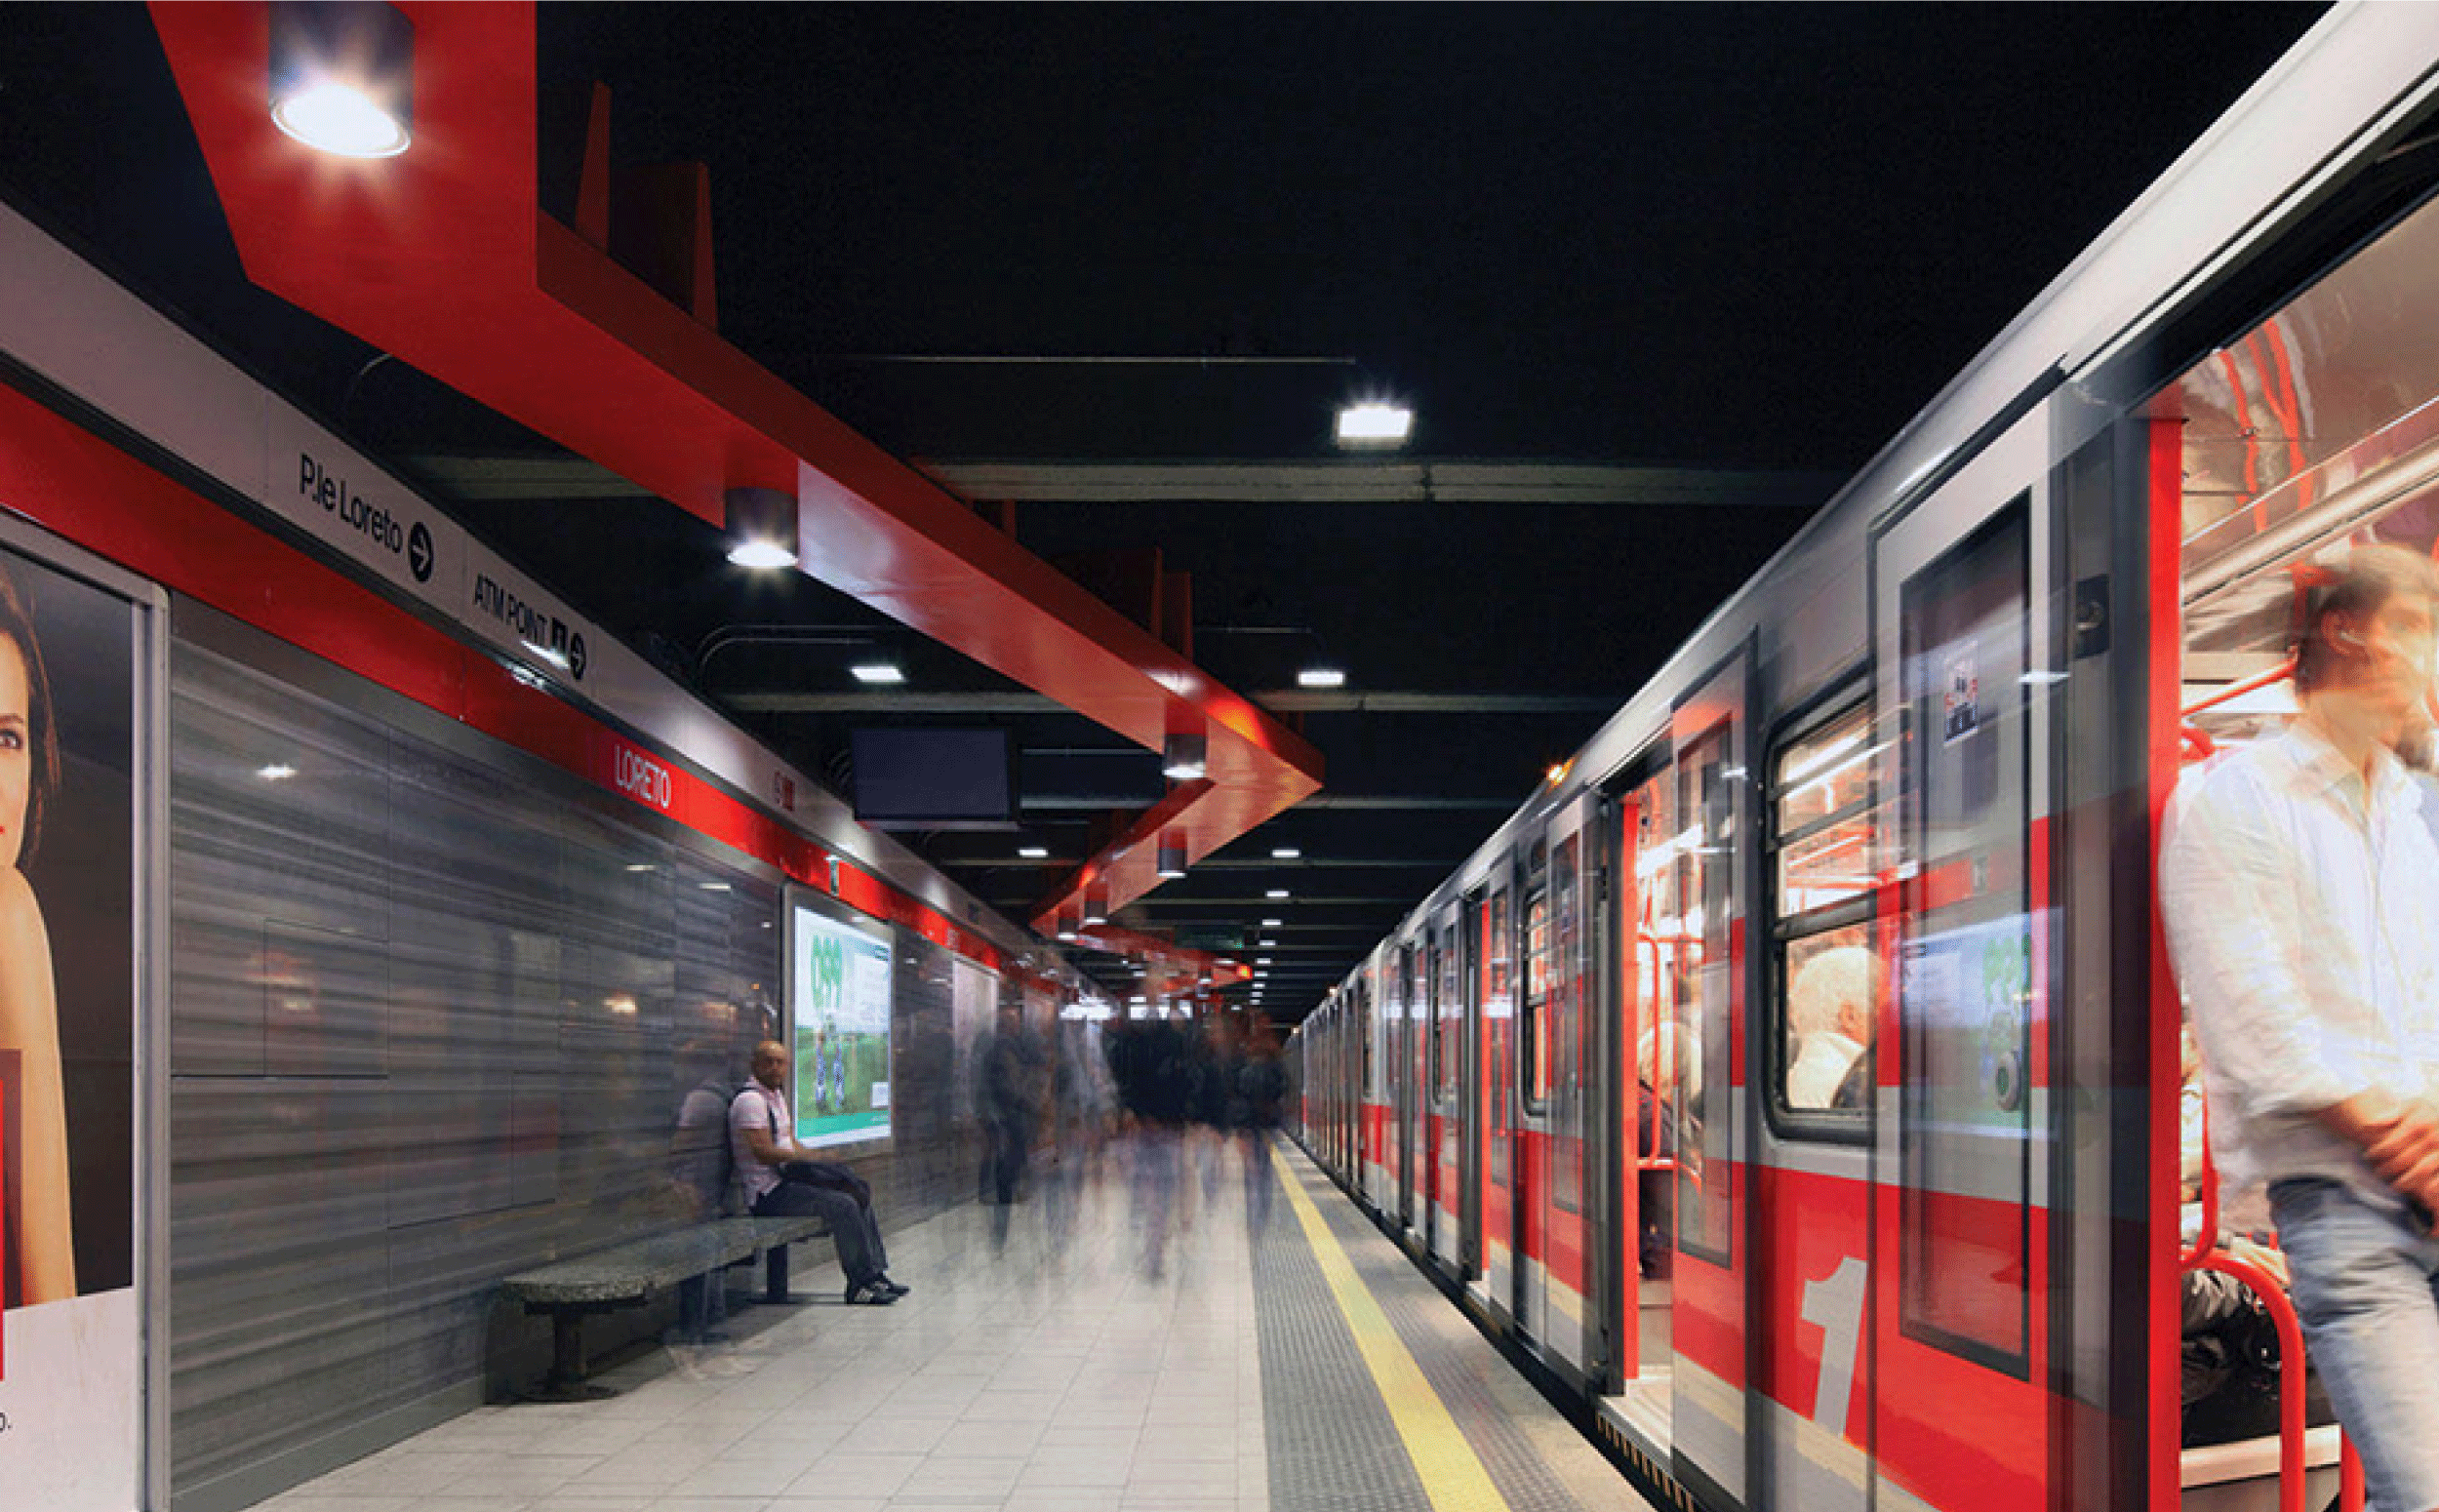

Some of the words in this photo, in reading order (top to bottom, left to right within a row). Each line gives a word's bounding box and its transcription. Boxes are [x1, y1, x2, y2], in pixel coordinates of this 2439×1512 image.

[300, 453, 337, 511] P.le
[340, 480, 404, 553] Loreto
[474, 574, 504, 622] ATM
[506, 594, 548, 647] POINT
[615, 744, 671, 809] LORETO
[1801, 1254, 1867, 1439] 1
